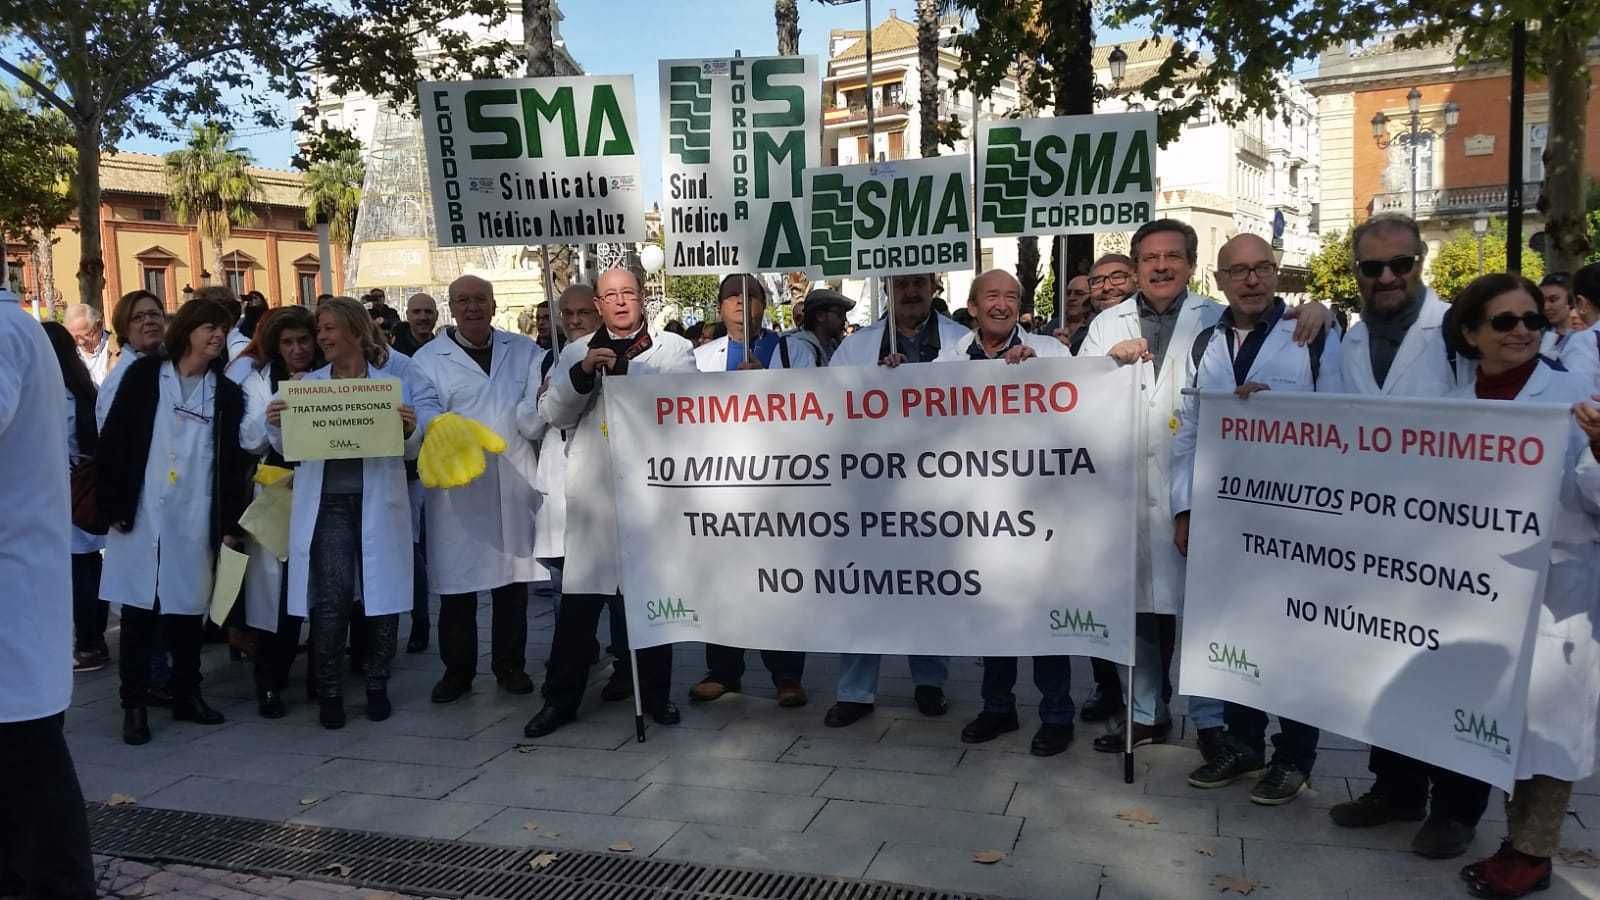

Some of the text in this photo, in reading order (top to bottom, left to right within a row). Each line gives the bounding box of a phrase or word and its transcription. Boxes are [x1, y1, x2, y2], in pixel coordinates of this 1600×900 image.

[465, 84, 635, 160] SMA
[433, 91, 466, 243] CÓRDOBA
[751, 58, 807, 269] SMA
[1028, 129, 1153, 199] SMA
[499, 171, 609, 200] Sindicato
[670, 172, 713, 200] Sind.
[477, 208, 625, 238] Médico Andaluz
[671, 207, 728, 233] Médico
[853, 172, 970, 240] SMA
[1031, 201, 1150, 228] CÓRDOBA
[673, 241, 739, 267] Andaluz
[857, 242, 968, 270] CÓRDOBA
[288, 384, 393, 396] PRIMARIA, LO PRIMERO
[655, 381, 1079, 426] PRIMARIA, LO PRIMERO
[292, 402, 392, 414] TRATAMOS PERSONAS
[312, 417, 375, 428] NO NÚMEROS
[1220, 416, 1544, 466] PRIMARIA, LO PRIMERO
[647, 447, 1096, 482] 10 MINUTOS POR CONSULTA
[1217, 475, 1541, 537] 10 MINUTOS POR CONSULTA
[684, 511, 850, 537] TRATAMOS
[757, 561, 982, 596] NO NÚMEROS
[1242, 532, 1499, 602] TRATAMOS PERSONAS,
[1286, 597, 1440, 651] NO NÚMEROS
